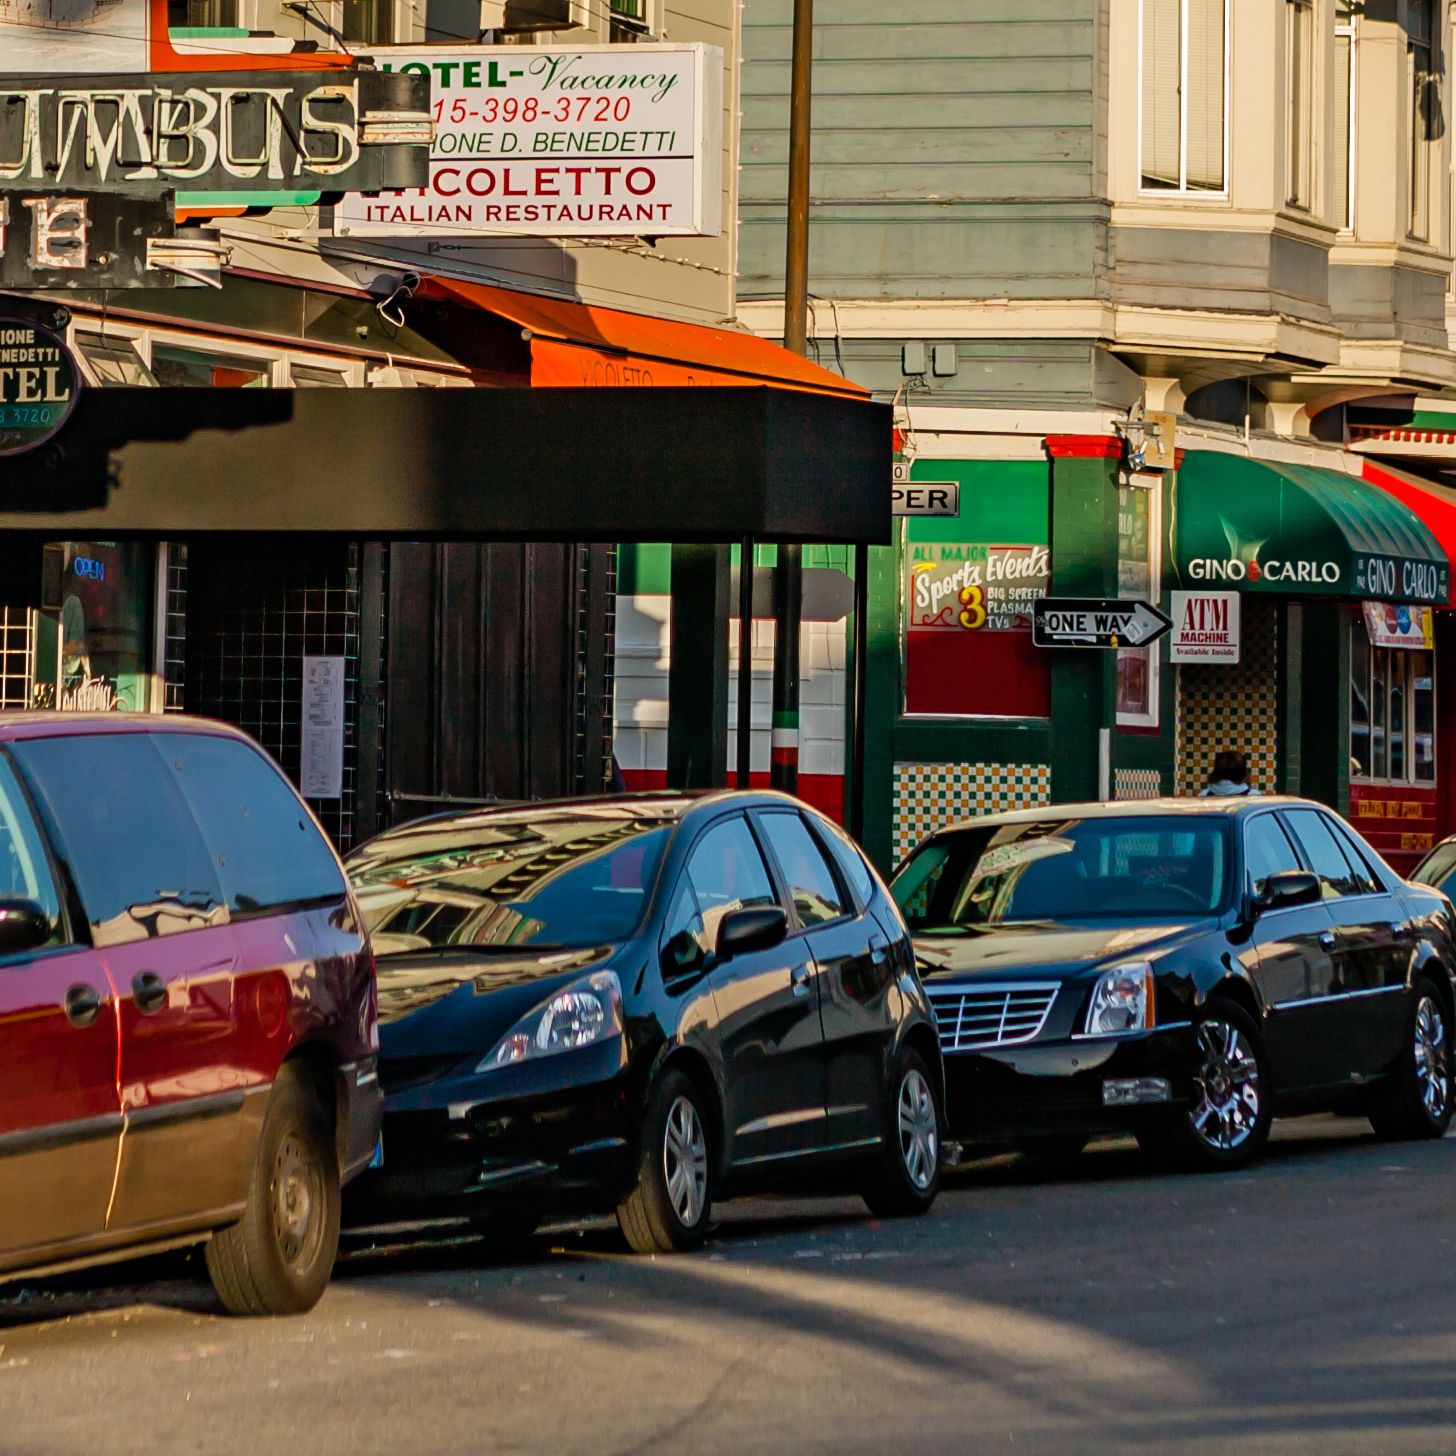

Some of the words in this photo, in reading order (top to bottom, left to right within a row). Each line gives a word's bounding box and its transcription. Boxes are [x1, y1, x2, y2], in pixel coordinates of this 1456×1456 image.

[382, 58, 524, 89] TEL-
[529, 55, 678, 103] Vacancy
[432, 95, 631, 124] 15-398-3720
[431, 132, 491, 154] IONE
[501, 132, 523, 153] D.
[533, 130, 676, 153] BENEDETTI
[391, 166, 657, 197] COLETTO
[366, 204, 473, 222] ITALIAN
[486, 202, 673, 222] RESTAURANT
[894, 466, 903, 479] 0
[892, 489, 949, 510] PER
[912, 546, 936, 561] ALL
[940, 545, 988, 561] MAJOR
[916, 560, 983, 614] Sports
[986, 546, 1051, 582] Events
[1188, 558, 1246, 581] GINO
[1263, 560, 1341, 583] CARLO
[1368, 558, 1395, 595] GINO
[1403, 560, 1437, 599] CARLO
[957, 584, 989, 630] 3
[987, 587, 1005, 599] BIG
[1008, 586, 1047, 599] SCREEN
[987, 602, 1034, 614] PLASMA
[1183, 598, 1229, 632] ATM
[987, 615, 1010, 629] TVs
[1048, 613, 1087, 632] ONE
[1094, 614, 1134, 634] WAY
[1180, 632, 1230, 643] MACHINE
